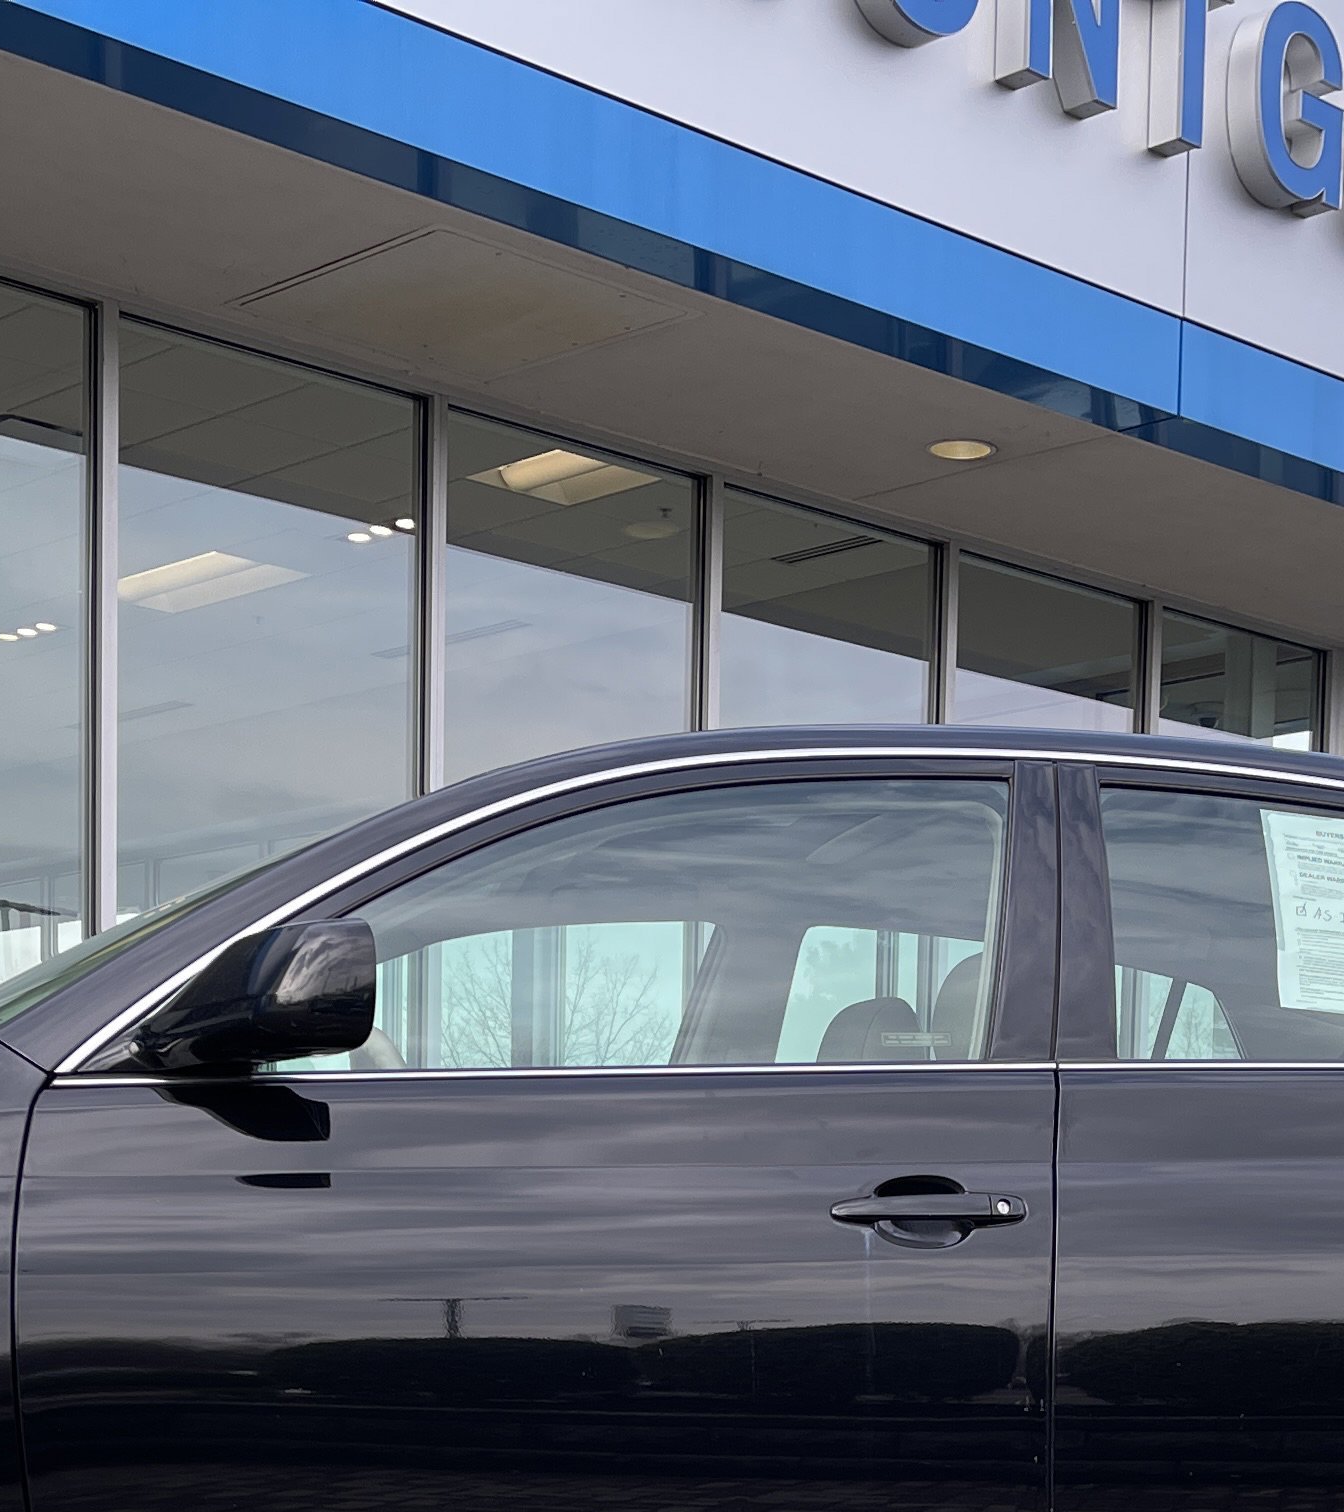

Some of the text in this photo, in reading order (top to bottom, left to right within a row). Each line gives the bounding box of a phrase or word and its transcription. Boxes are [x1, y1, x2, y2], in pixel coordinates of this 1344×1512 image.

[1315, 830, 1344, 840] BUYERS
[1299, 872, 1325, 881] DEALER
[1313, 906, 1332, 921] AS
